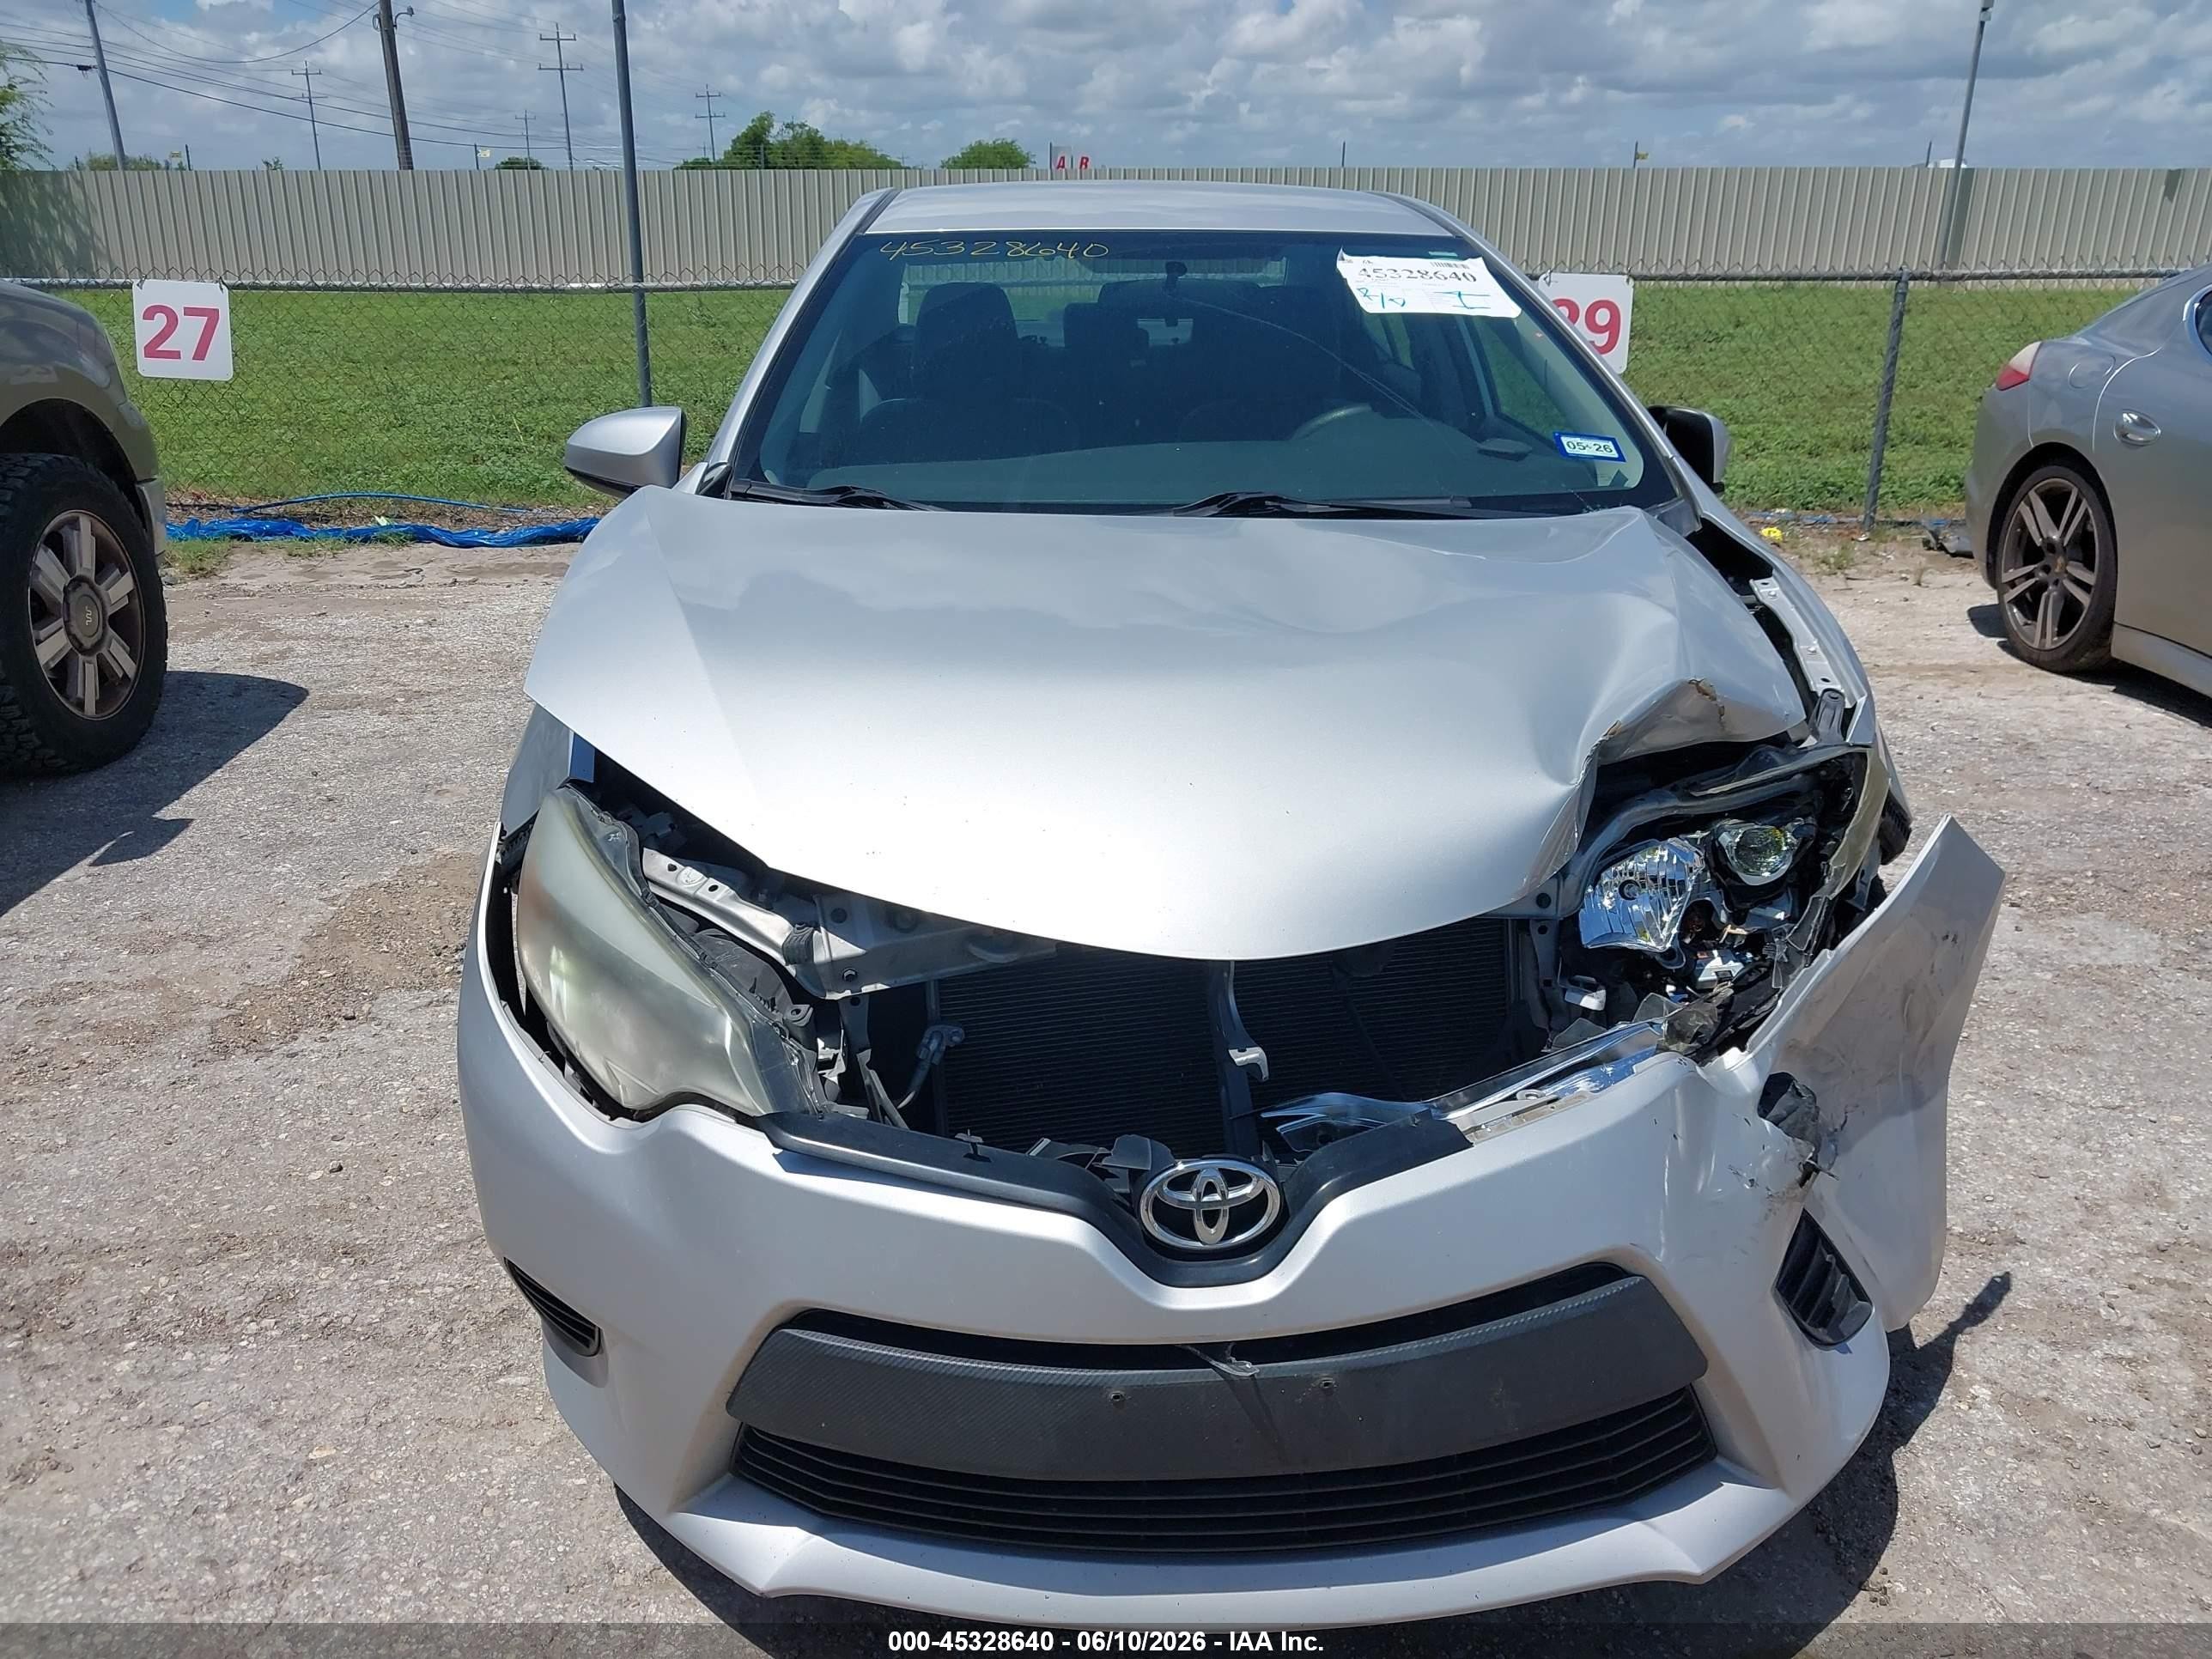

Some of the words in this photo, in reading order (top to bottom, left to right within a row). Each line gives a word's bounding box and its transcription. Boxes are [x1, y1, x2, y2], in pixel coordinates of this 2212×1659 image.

[879, 240, 1109, 261] 45328640
[1358, 268, 1477, 283] 45328640
[143, 304, 220, 362] 27
